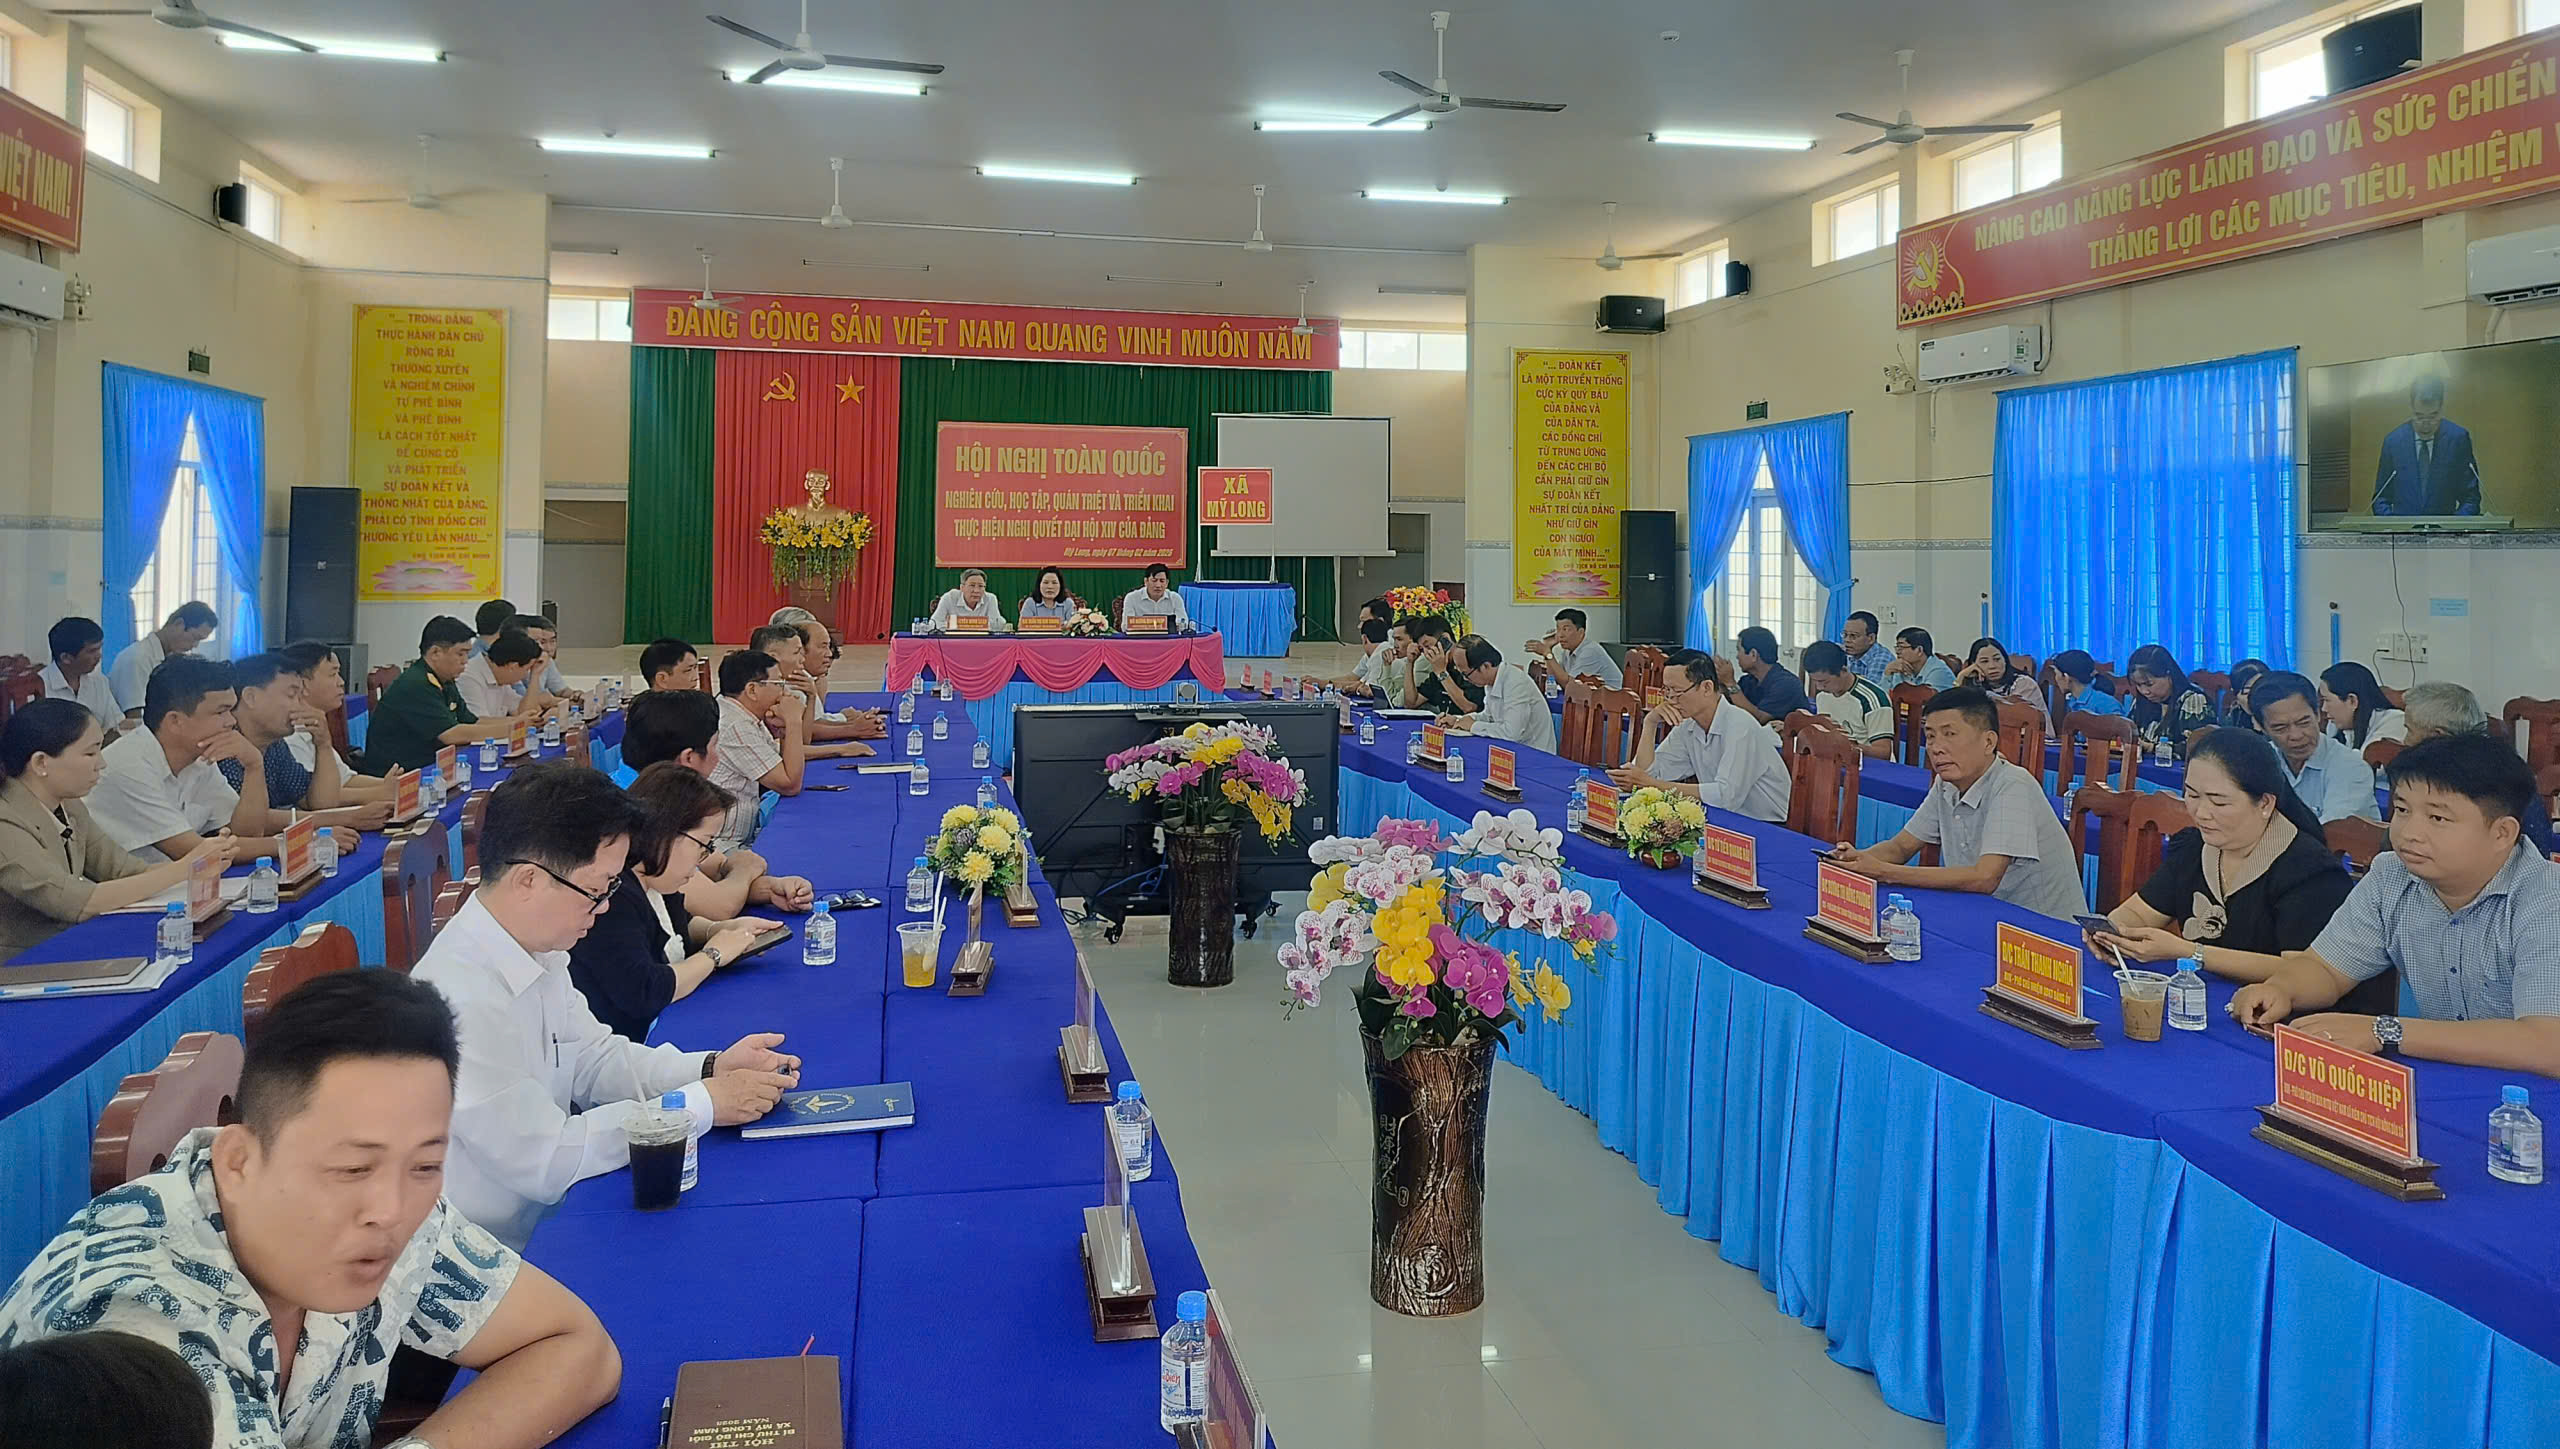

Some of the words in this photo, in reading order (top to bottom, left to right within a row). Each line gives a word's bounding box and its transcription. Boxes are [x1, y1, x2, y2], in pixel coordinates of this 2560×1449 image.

[1974, 216, 2025, 252] NÂNG
[2030, 202, 2067, 237] CAO
[2074, 187, 2131, 224] NĂNG
[2139, 168, 2182, 209] LỰC
[2189, 146, 2254, 195] LÃNH
[2261, 129, 2316, 175] ĐẠO
[2325, 109, 2363, 155] VÀ
[2373, 93, 2436, 143] SỨC
[2448, 51, 2557, 121] CHIẾN
[33, 148, 73, 219] NAM!
[2088, 223, 2159, 269] THẮNG
[2167, 214, 2202, 255] LỢI
[2210, 198, 2261, 241] CÁC
[2269, 182, 2332, 228] MỤC
[2340, 162, 2415, 209] TIÊU,
[2427, 129, 2543, 191] NHIỆM
[408, 313, 442, 325] TRONG
[666, 295, 738, 338] ĐẢNG
[750, 301, 819, 347] CỘNG
[831, 303, 882, 345] SẢN
[893, 308, 949, 352] VIỆT
[959, 319, 1015, 350] NAM
[1025, 321, 1107, 353] QUANG
[1118, 326, 1172, 356] VINH
[1181, 321, 1249, 359] MUÔN
[1258, 325, 1312, 361] NĂM
[1558, 359, 1582, 370] ĐOÀN
[1585, 358, 1602, 371] KẾT
[1521, 373, 1533, 384] LÀ
[1535, 373, 1555, 385] MỘT
[1557, 373, 1592, 385] TRUYỀN
[1594, 373, 1623, 385] THỐNG
[1536, 389, 1553, 400] CỰC
[1556, 388, 1568, 399] KỲ
[1571, 388, 1588, 400] QUÝ
[1591, 388, 1609, 399] BÁU
[1543, 402, 1561, 413] CỦA
[1563, 402, 1587, 413] ĐẢNG
[1589, 402, 1601, 414] VÀ
[1545, 416, 1562, 427] CỦA
[1565, 416, 1583, 428] DÂN
[1585, 419, 1599, 428] TA.
[1542, 431, 1559, 441] CÁC
[1561, 430, 1586, 442] ĐỒNG
[1588, 431, 1602, 442] CHÍ
[1538, 444, 1550, 456] TỪ
[1552, 447, 1581, 457] TRUNG
[1583, 447, 1606, 457] ƯƠNG
[955, 441, 991, 478] HỘI
[997, 447, 1047, 479] NGHỊ
[1053, 443, 1106, 475] TOÀN
[1112, 441, 1166, 478] QUỐC
[1537, 459, 1555, 470] ĐẾN
[1558, 460, 1575, 471] CÁC
[1577, 461, 1592, 471] CHI
[1594, 460, 1607, 473] BỘ
[1223, 474, 1249, 495] XÃ
[1535, 473, 1552, 484] CẦN
[1555, 473, 1575, 485] PHẢI
[1578, 474, 1594, 485] GIỮ
[1595, 474, 1609, 485] GÌN
[945, 488, 982, 509] NGHIÊN
[984, 488, 1007, 512] CỨU,
[1009, 492, 1029, 513] HỌC
[1032, 489, 1050, 513] TẬP,
[1053, 490, 1079, 511] QUÁN
[1081, 490, 1106, 514] TRIỆT
[1108, 490, 1121, 511] VÀ
[1123, 488, 1150, 512] TRIỂN
[1152, 494, 1175, 512] KHAI
[1543, 489, 1555, 501] SỰ
[1557, 488, 1581, 499] ĐOÀN
[1583, 488, 1601, 500] KẾT
[1207, 498, 1228, 518] MỸ
[1231, 501, 1266, 518] LONG
[1529, 502, 1553, 514] NHẤT
[1555, 503, 1569, 514] TRÍ
[1571, 502, 1589, 514] CỦA
[1592, 502, 1615, 515] ĐẢNG
[953, 518, 979, 541] THỰC
[981, 516, 1004, 541] HIỆN
[1006, 518, 1030, 542] NGHỊ
[1032, 514, 1062, 539] QUYẾT
[1064, 519, 1081, 542] ĐẠI
[1082, 517, 1099, 542] HỘI
[1100, 521, 1116, 539] XIV
[1118, 515, 1137, 539] CỦA
[1139, 515, 1166, 539] ĐẢNG
[1546, 518, 1565, 528] NHƯ
[1567, 517, 1582, 528] GIỮ
[1584, 517, 1598, 529] GÌN
[1549, 534, 1567, 543] CON
[1533, 545, 1551, 557] CỦA
[2283, 1048, 2307, 1076] Đ/C
[2308, 1056, 2326, 1084] VÕ
[2328, 1064, 2365, 1098] QUỐC
[2368, 1079, 2402, 1113] HIỆP
